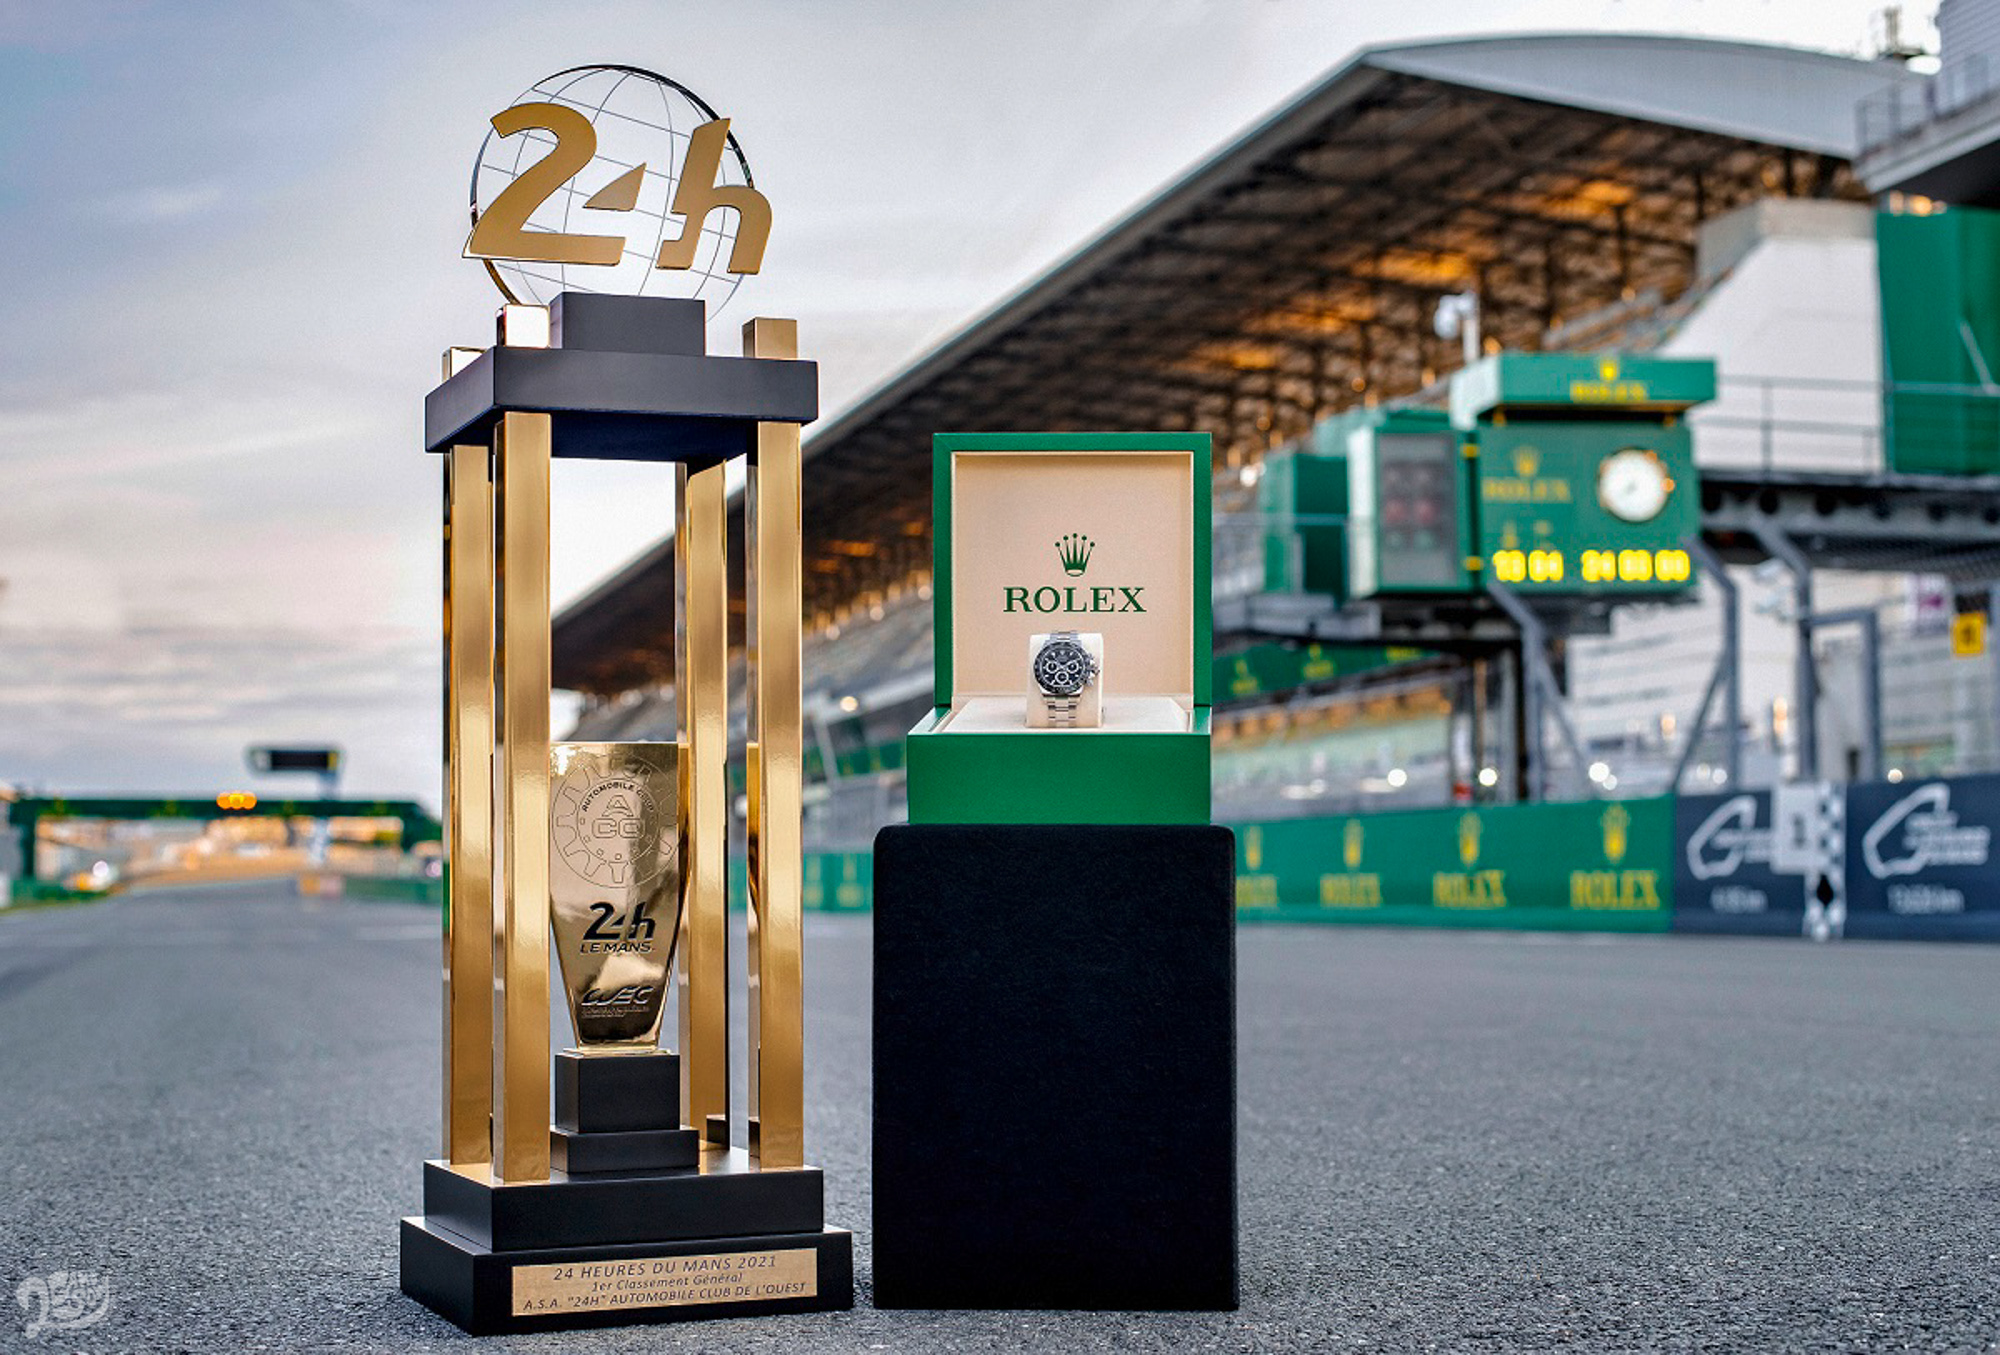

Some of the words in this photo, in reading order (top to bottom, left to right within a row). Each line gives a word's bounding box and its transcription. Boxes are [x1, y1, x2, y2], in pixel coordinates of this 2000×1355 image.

[1003, 586, 1147, 613] ROLEX
[583, 901, 656, 940] 24h
[580, 942, 601, 954] LE
[603, 941, 652, 953] MANS
[553, 1267, 574, 1281] 24
[581, 1262, 646, 1279] HEURES
[652, 1261, 676, 1274] DU
[682, 1257, 732, 1272] MANS
[737, 1255, 776, 1269] 2021
[591, 1281, 612, 1292] 1er
[616, 1276, 690, 1291] Classement
[693, 1272, 743, 1286] Général
[523, 1298, 562, 1311] A.S.A.
[609, 1288, 695, 1305] AUTOMOBILE
[699, 1287, 731, 1299] CLUB
[734, 1286, 751, 1296] DE
[755, 1281, 806, 1296] L'OUEST
